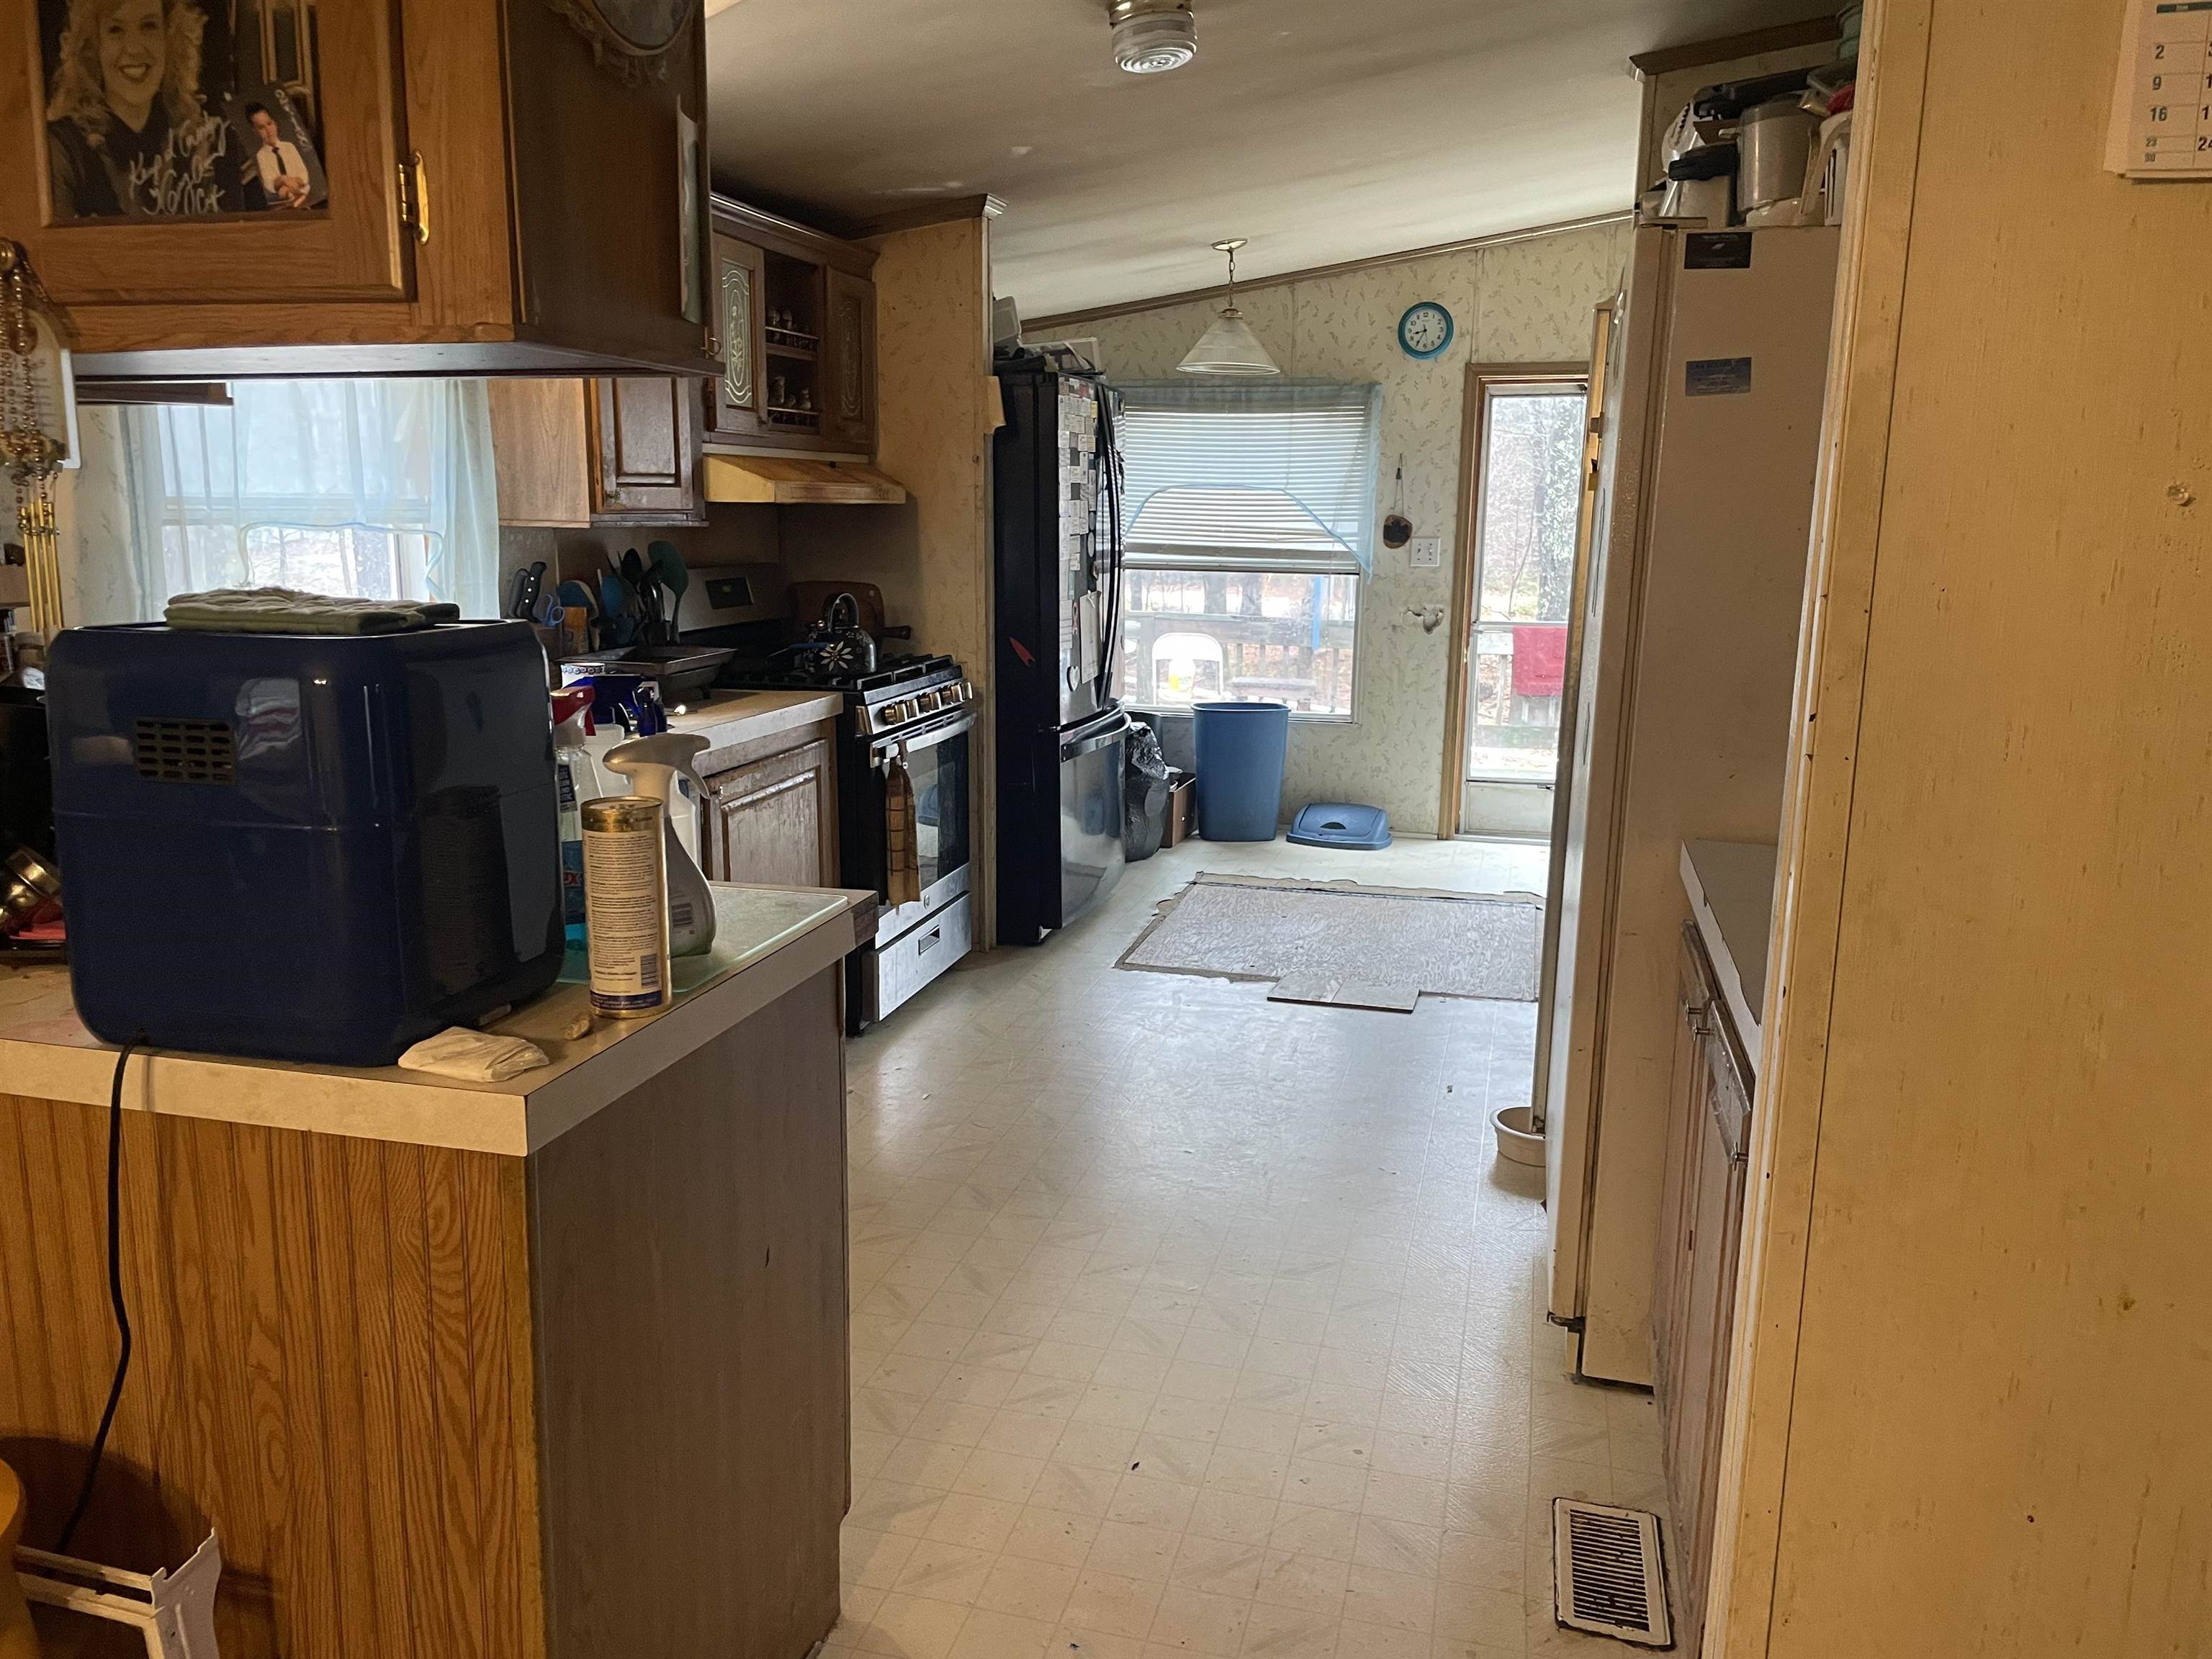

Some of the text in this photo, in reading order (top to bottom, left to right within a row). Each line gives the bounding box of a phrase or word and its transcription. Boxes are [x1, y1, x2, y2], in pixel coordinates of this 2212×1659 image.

[2154, 45, 2164, 59] 2
[2152, 76, 2162, 90] 9
[2149, 106, 2167, 122] 16
